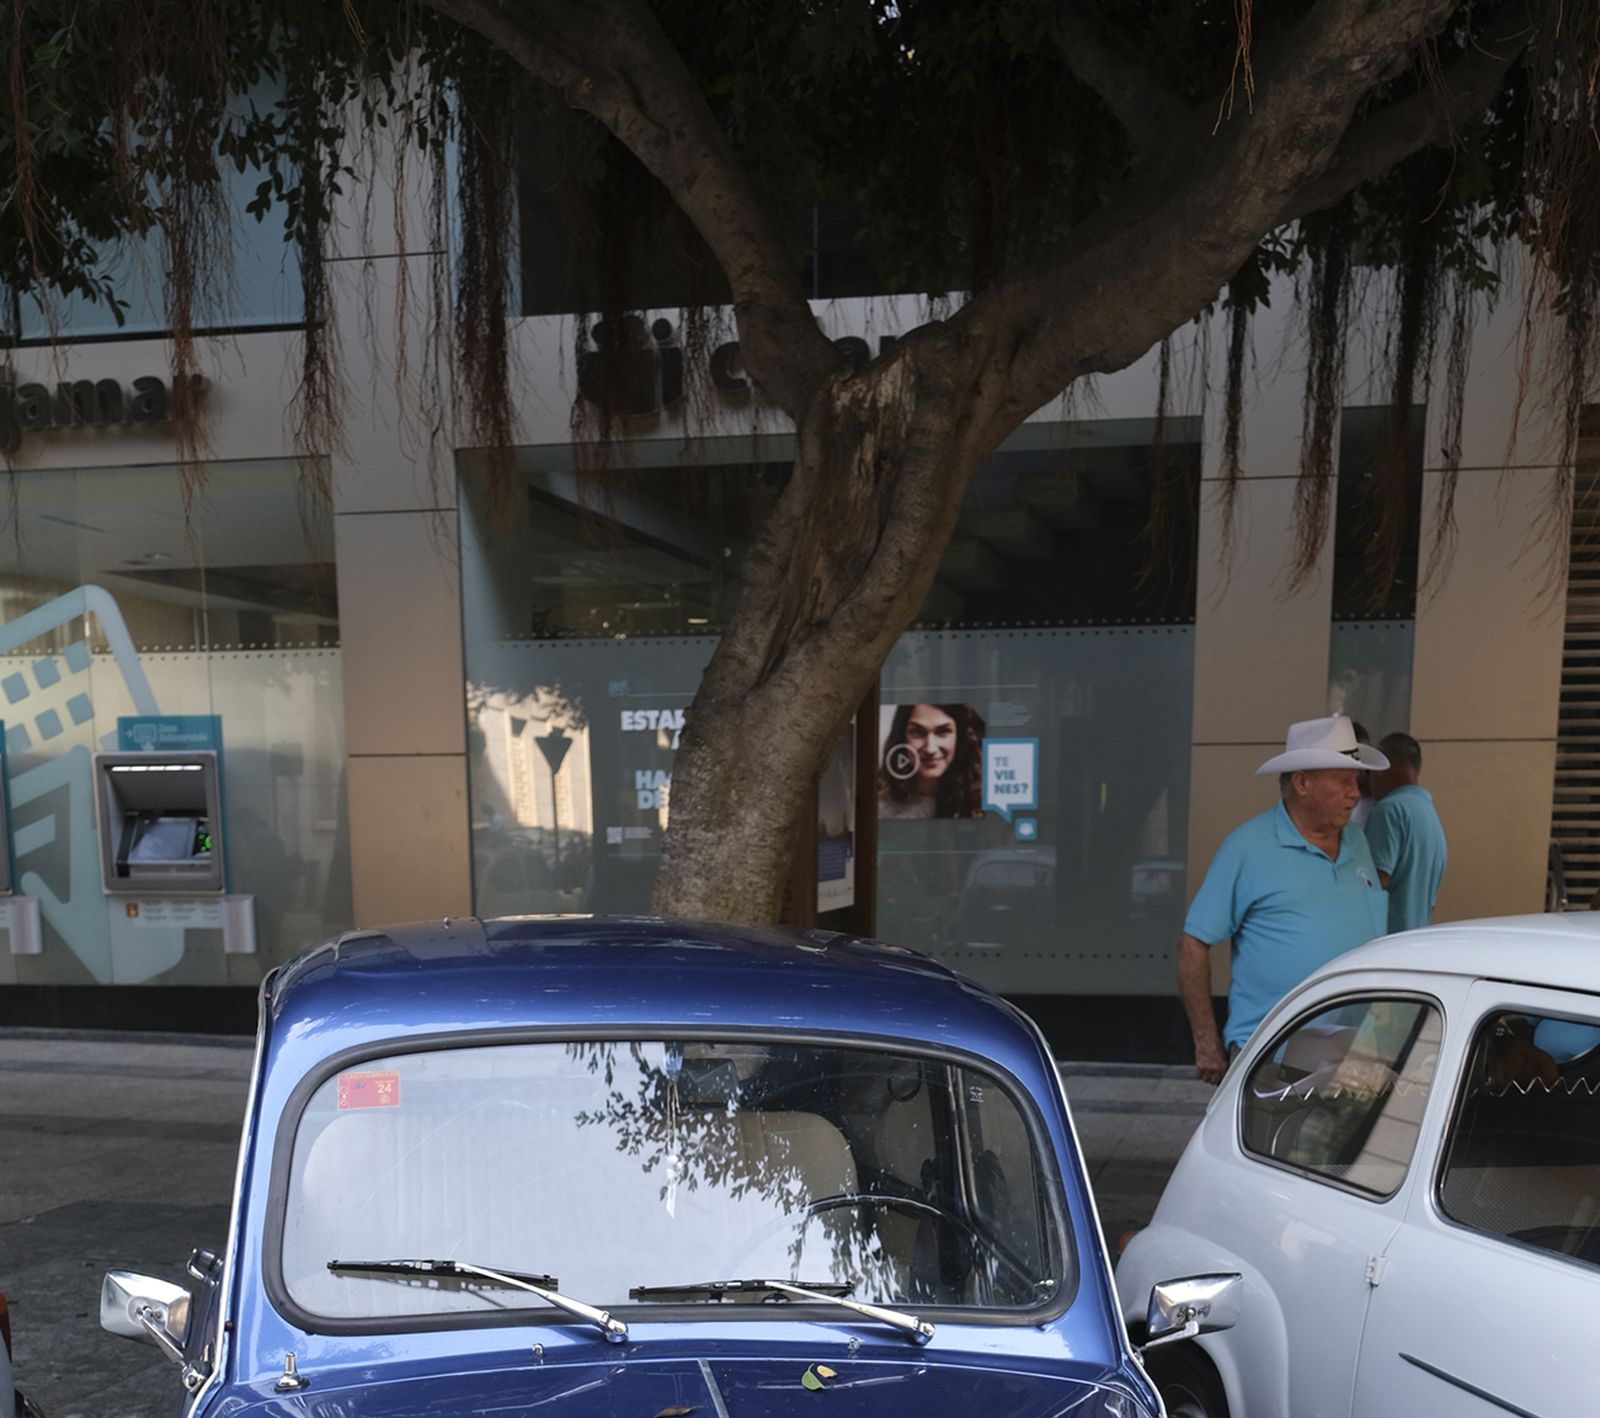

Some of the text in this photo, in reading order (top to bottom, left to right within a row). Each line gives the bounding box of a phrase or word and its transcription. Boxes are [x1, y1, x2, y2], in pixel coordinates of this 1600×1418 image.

[995, 756, 1009, 767] TE
[635, 770, 672, 789] HA
[994, 770, 1015, 780] VIE
[994, 783, 1028, 794] NES?
